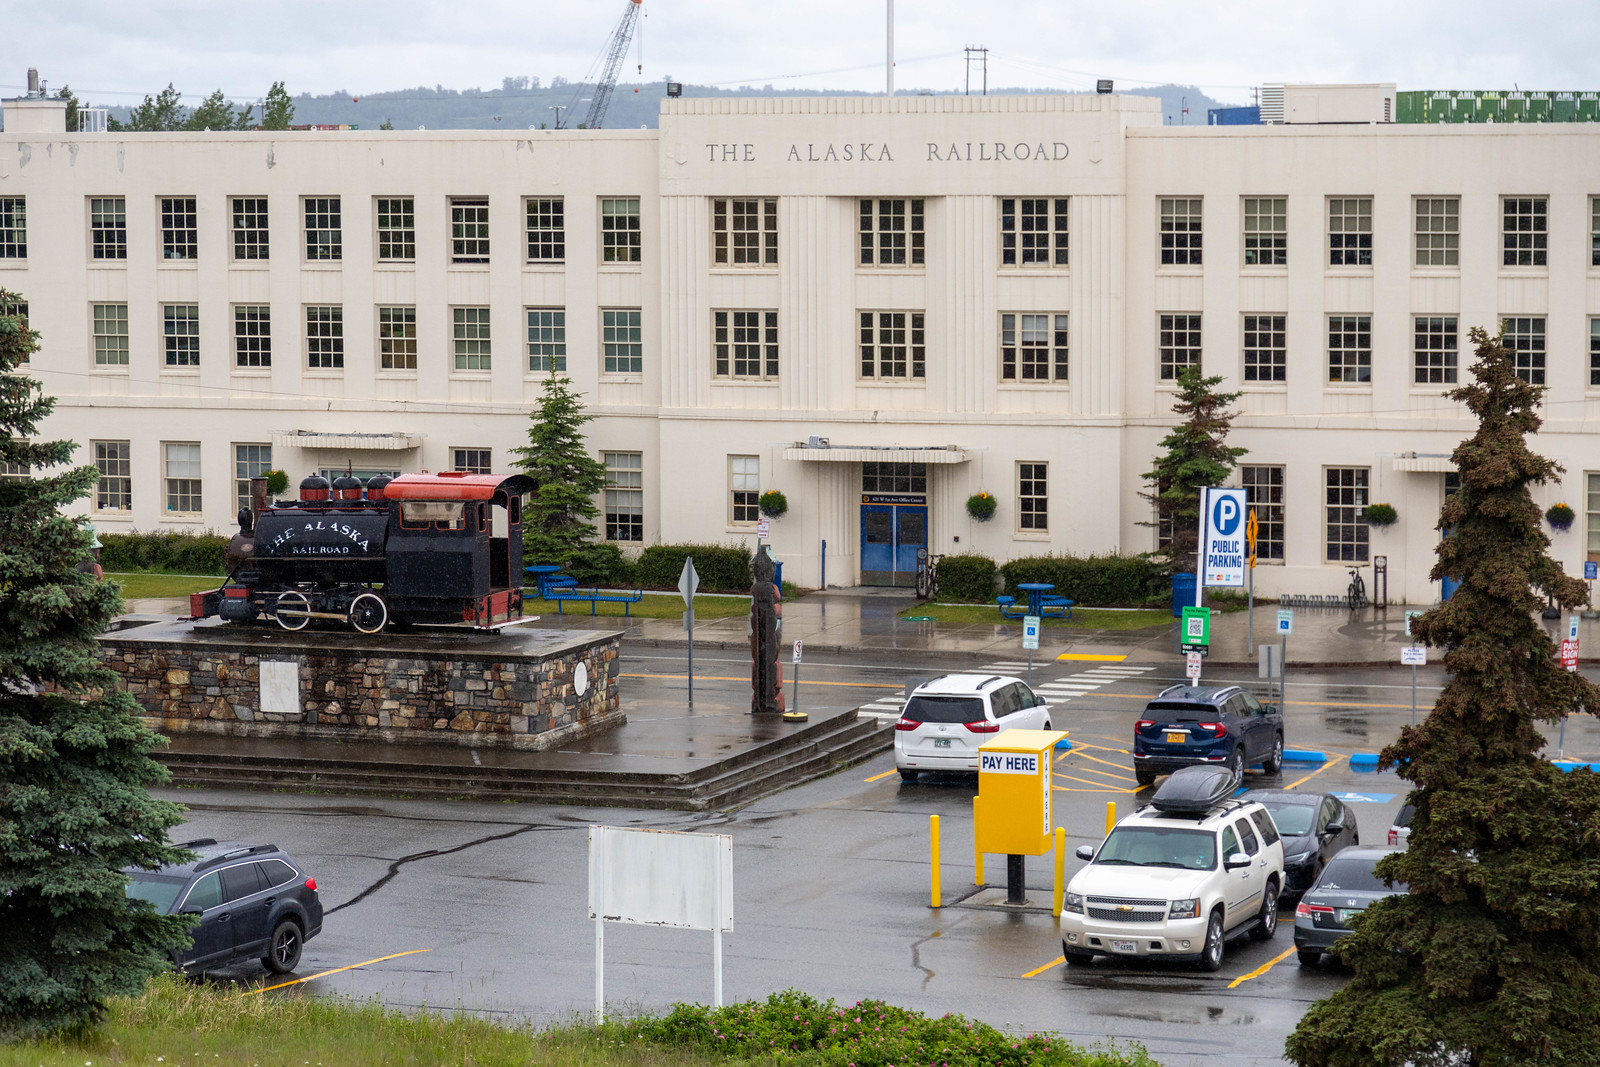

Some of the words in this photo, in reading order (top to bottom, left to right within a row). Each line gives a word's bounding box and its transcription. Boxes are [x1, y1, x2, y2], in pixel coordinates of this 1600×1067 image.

[1432, 91, 1451, 100] AML
[1457, 91, 1476, 100] AML
[1482, 91, 1501, 100] AML
[1507, 91, 1526, 100] AML
[1530, 91, 1549, 100] AML
[1556, 92, 1574, 101] AML
[1580, 92, 1599, 100] AML
[705, 144, 756, 162] THE
[787, 143, 895, 162] ALASKA
[927, 142, 1070, 161] RAILROAD
[304, 521, 369, 552] ALASKA
[292, 546, 349, 554] RAILROAD
[1212, 540, 1240, 553] PUBLIC
[1208, 555, 1242, 568] PARKING
[982, 756, 1003, 769] PAY
[1006, 757, 1036, 771] HERE
